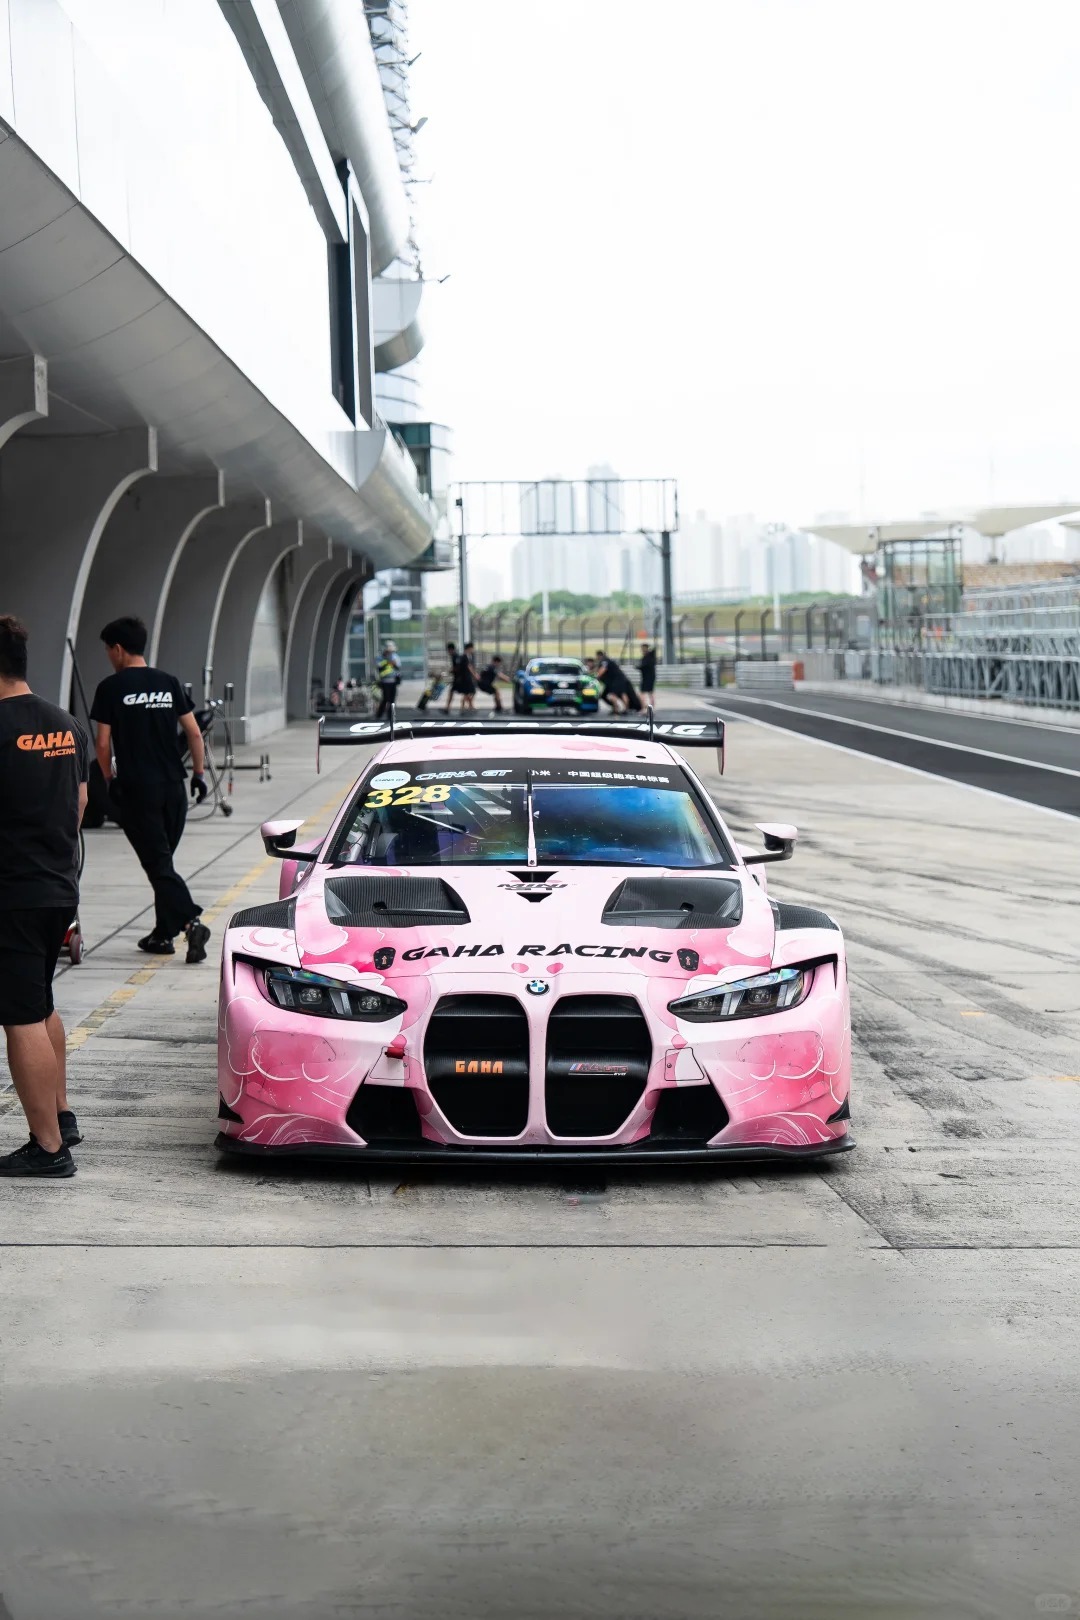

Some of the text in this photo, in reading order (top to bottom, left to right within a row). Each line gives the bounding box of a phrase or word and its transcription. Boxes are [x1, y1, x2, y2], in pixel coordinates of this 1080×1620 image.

[123, 692, 173, 705] GAHA
[16, 730, 75, 750] GAHA
[44, 748, 76, 758] RACING
[415, 770, 478, 780] CHINA
[364, 784, 451, 808] 328
[402, 944, 674, 963] GAHA RACING
[456, 1060, 503, 1074] GAHA
